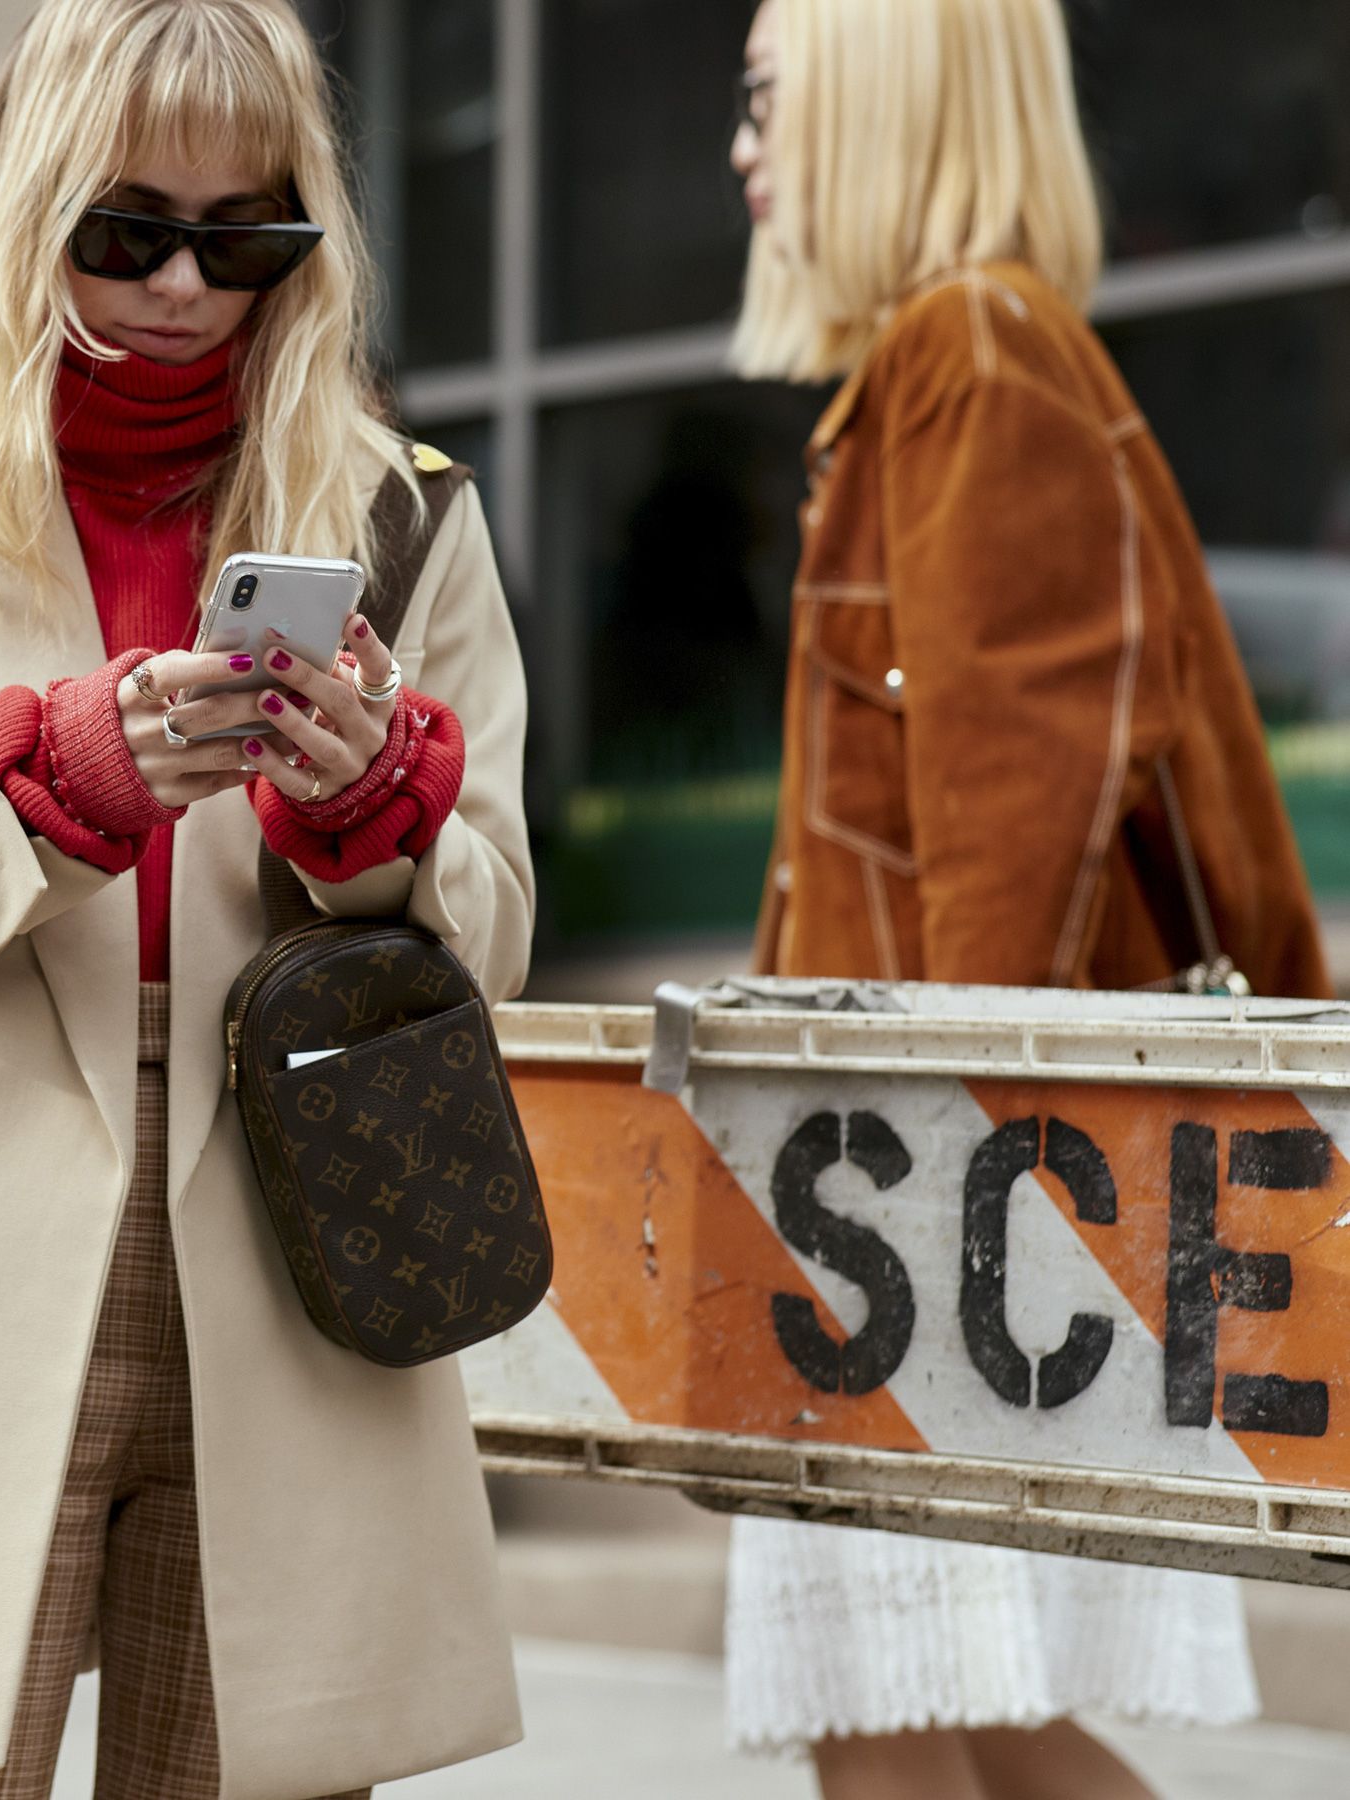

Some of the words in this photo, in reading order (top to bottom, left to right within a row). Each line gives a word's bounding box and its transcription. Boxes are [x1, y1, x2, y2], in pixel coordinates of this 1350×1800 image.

[385, 1122, 437, 1181] LV
[429, 1265, 479, 1325] LV
[770, 1110, 1334, 1438] SCE
